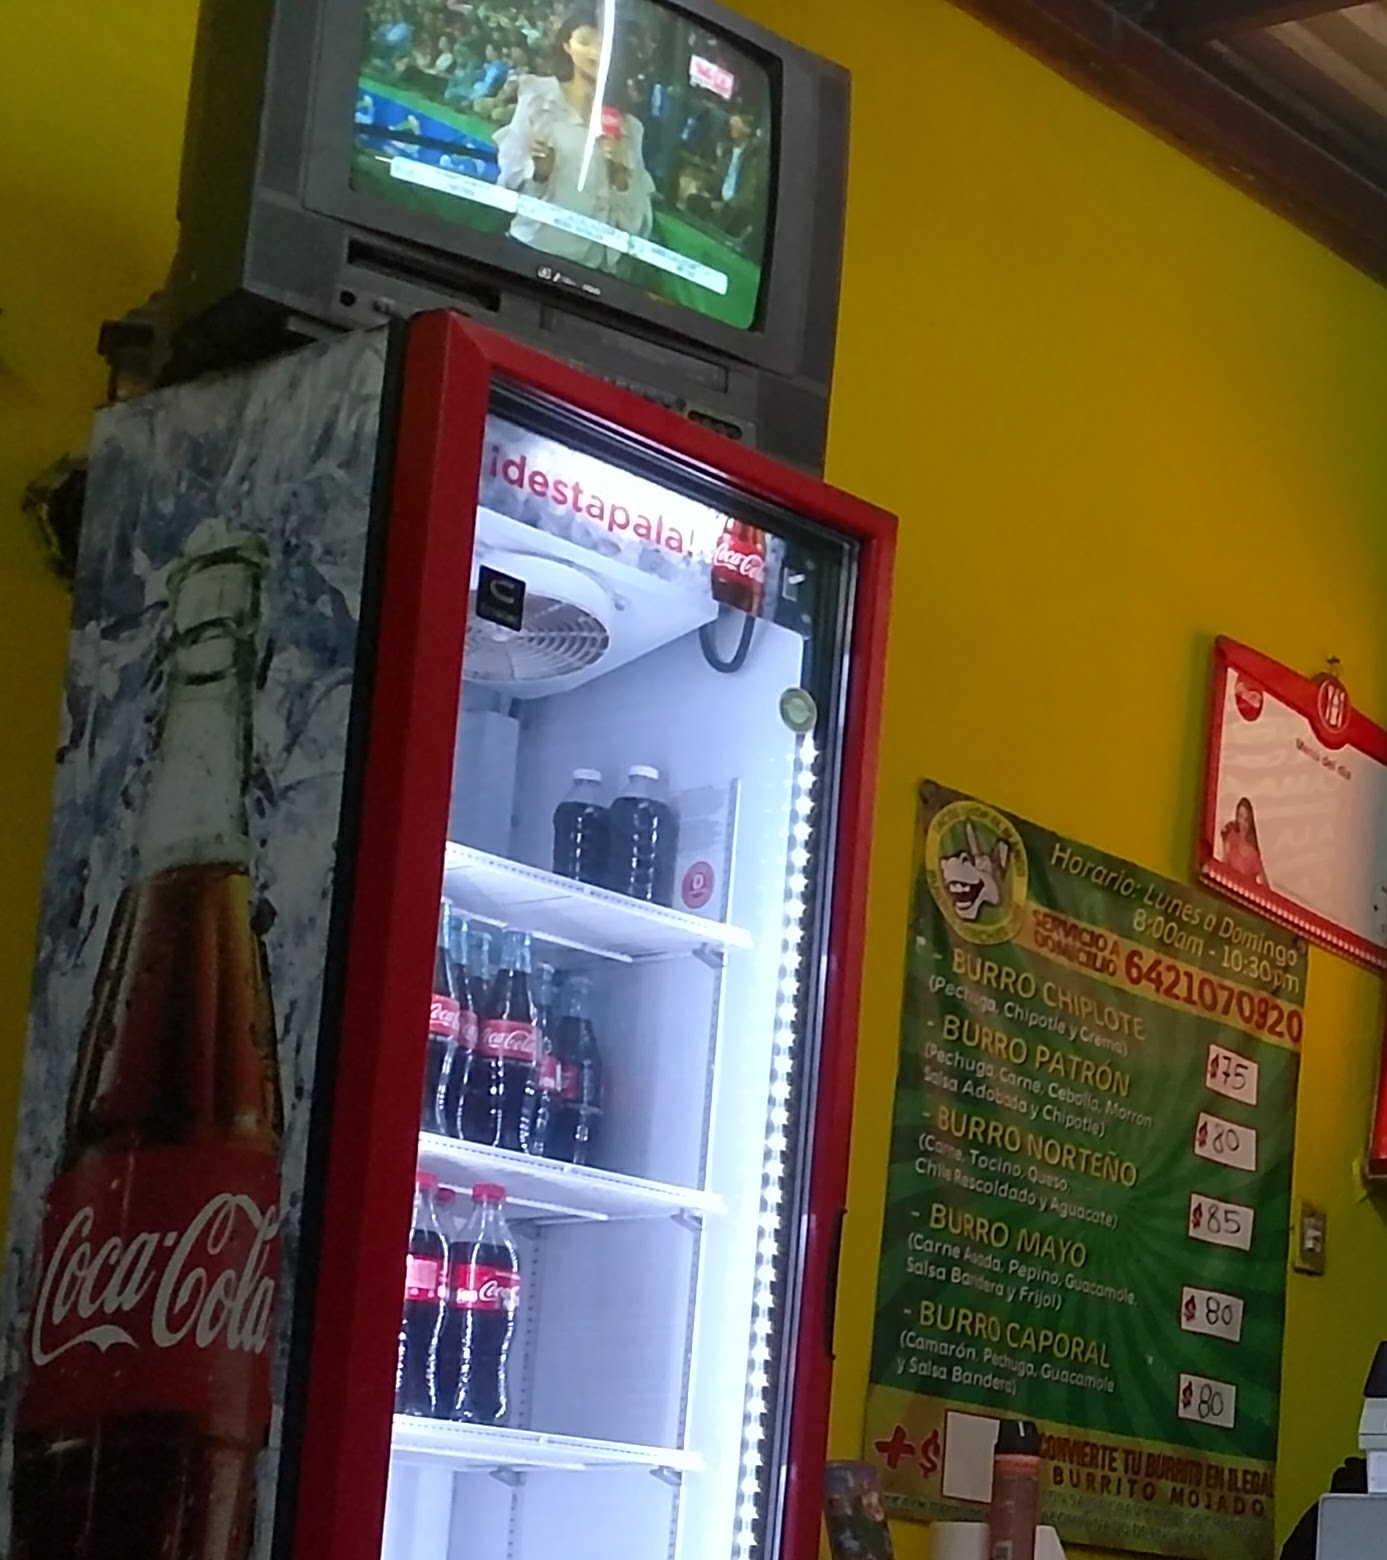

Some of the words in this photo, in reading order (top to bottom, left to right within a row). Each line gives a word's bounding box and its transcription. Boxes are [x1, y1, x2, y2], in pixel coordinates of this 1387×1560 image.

[1050, 842, 1141, 899] Horario:
[1145, 883, 1201, 928] Lunes
[1204, 914, 1214, 930] a
[1219, 915, 1298, 966] Domingo
[1032, 908, 1108, 953] SERVICIO
[1133, 908, 1202, 958] 8:00am
[1222, 943, 1299, 993] 10:30pm
[952, 948, 1036, 999] BURRO
[1043, 981, 1146, 1041] CHIPLOTE
[1125, 949, 1303, 1044] 6421070920
[942, 1015, 1028, 1064] BURRO
[1035, 1046, 1131, 1097] PATRÓN
[1208, 1054, 1249, 1091] $75
[924, 1066, 957, 1091] Salsa
[963, 1081, 1027, 1113] Adobada
[1029, 1101, 1038, 1120] y
[1043, 1105, 1105, 1138] Chipotle)
[938, 1105, 1020, 1152] BURRO
[1028, 1133, 1137, 1187] NORTEÑO
[1197, 1121, 1239, 1155] $80
[930, 1202, 1009, 1248] BURRO
[1016, 1228, 1087, 1268] MAYO
[1191, 1202, 1241, 1235] $85
[32, 1192, 279, 1366] Coca-Cola
[907, 1258, 946, 1282] Salsa
[1007, 1282, 1016, 1301] y
[1020, 1285, 1062, 1311] Frijol)
[920, 1300, 1001, 1342] BURRO
[1007, 1322, 1110, 1369] CAPORAL
[1184, 1295, 1233, 1326] $80
[908, 1357, 947, 1381] Salsa
[1182, 1381, 1224, 1419] $80
[1053, 1466, 1156, 1501] BURRITO
[1170, 1487, 1264, 1516] MOJADO
[1123, 1447, 1143, 1475] TU
[1205, 1464, 1224, 1489] EN
